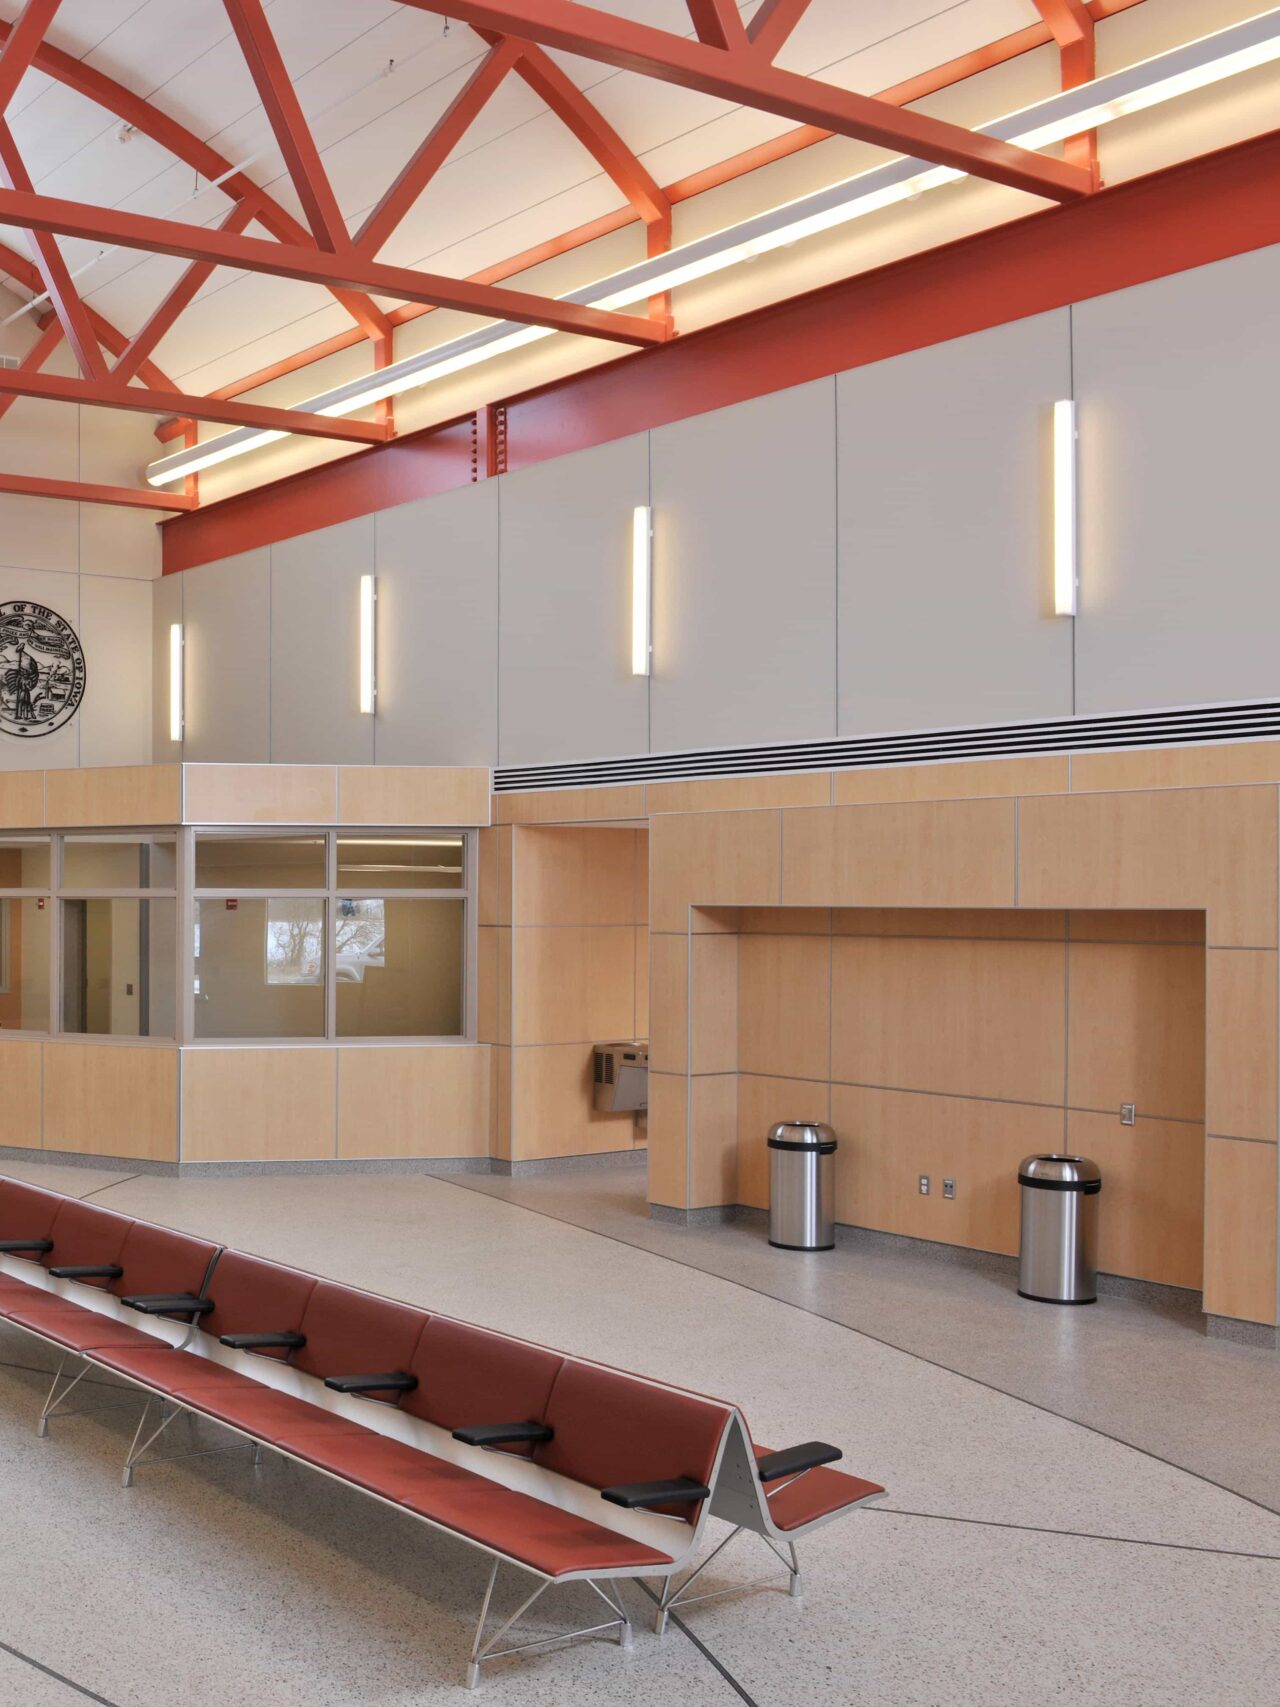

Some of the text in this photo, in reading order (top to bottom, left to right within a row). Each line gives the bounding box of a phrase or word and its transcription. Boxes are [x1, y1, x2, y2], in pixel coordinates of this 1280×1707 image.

[13, 604, 27, 613] OF
[31, 605, 53, 621] THE
[55, 620, 80, 654] STATE
